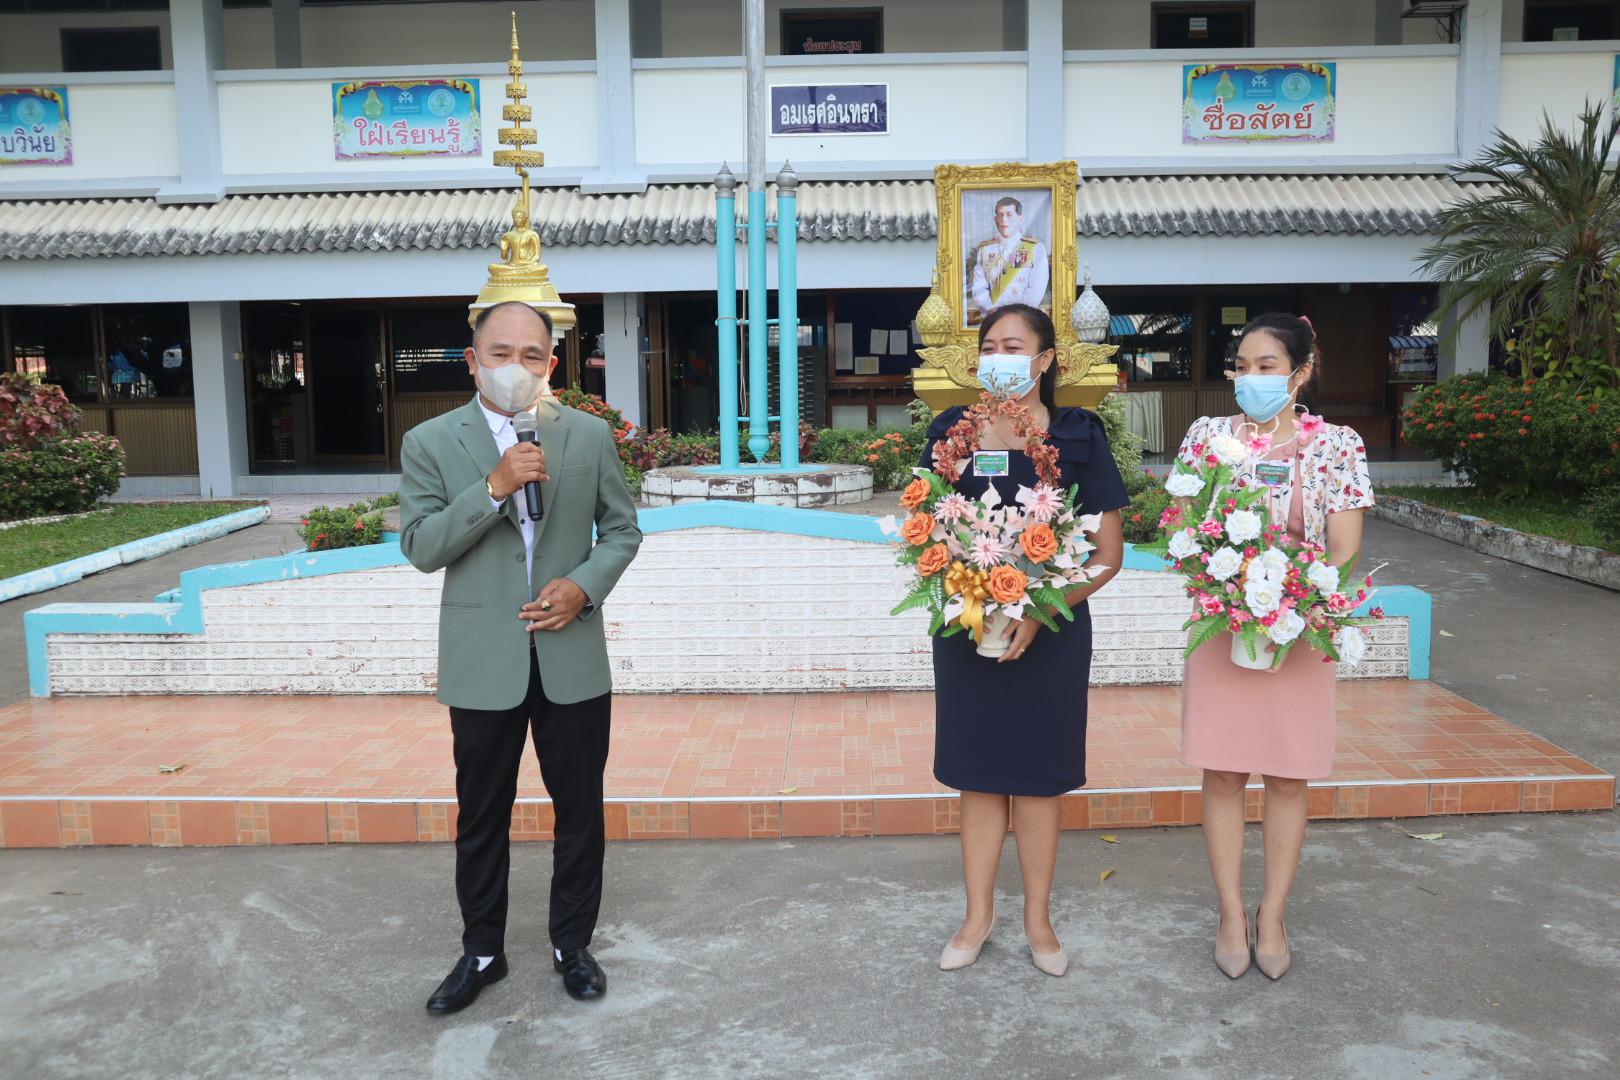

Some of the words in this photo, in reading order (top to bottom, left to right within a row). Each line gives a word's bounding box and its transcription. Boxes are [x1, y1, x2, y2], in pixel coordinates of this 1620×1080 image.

[779, 93, 878, 125] อมเรศอินทรา
[1203, 97, 1315, 130] ซื่อสัตย์
[353, 118, 461, 153] ใฝ่เรียนรู้
